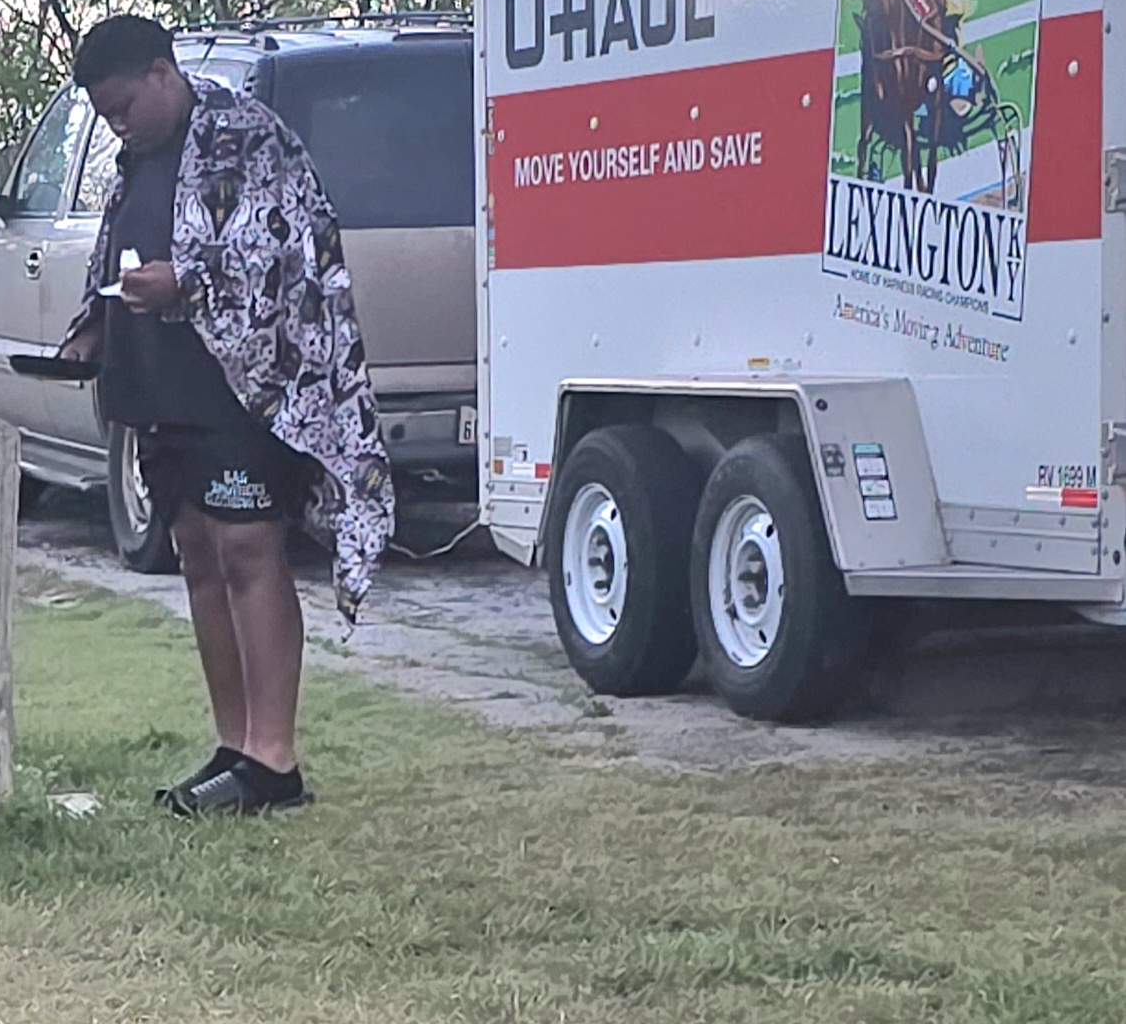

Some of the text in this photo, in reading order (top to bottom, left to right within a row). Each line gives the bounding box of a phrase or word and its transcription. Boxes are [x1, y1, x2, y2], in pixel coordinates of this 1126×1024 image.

[514, 131, 762, 188] MOVE YOURSELF AND SAVE
[827, 179, 1006, 297] LEXINGTON
[832, 293, 1010, 362] America's Moving Adventure
